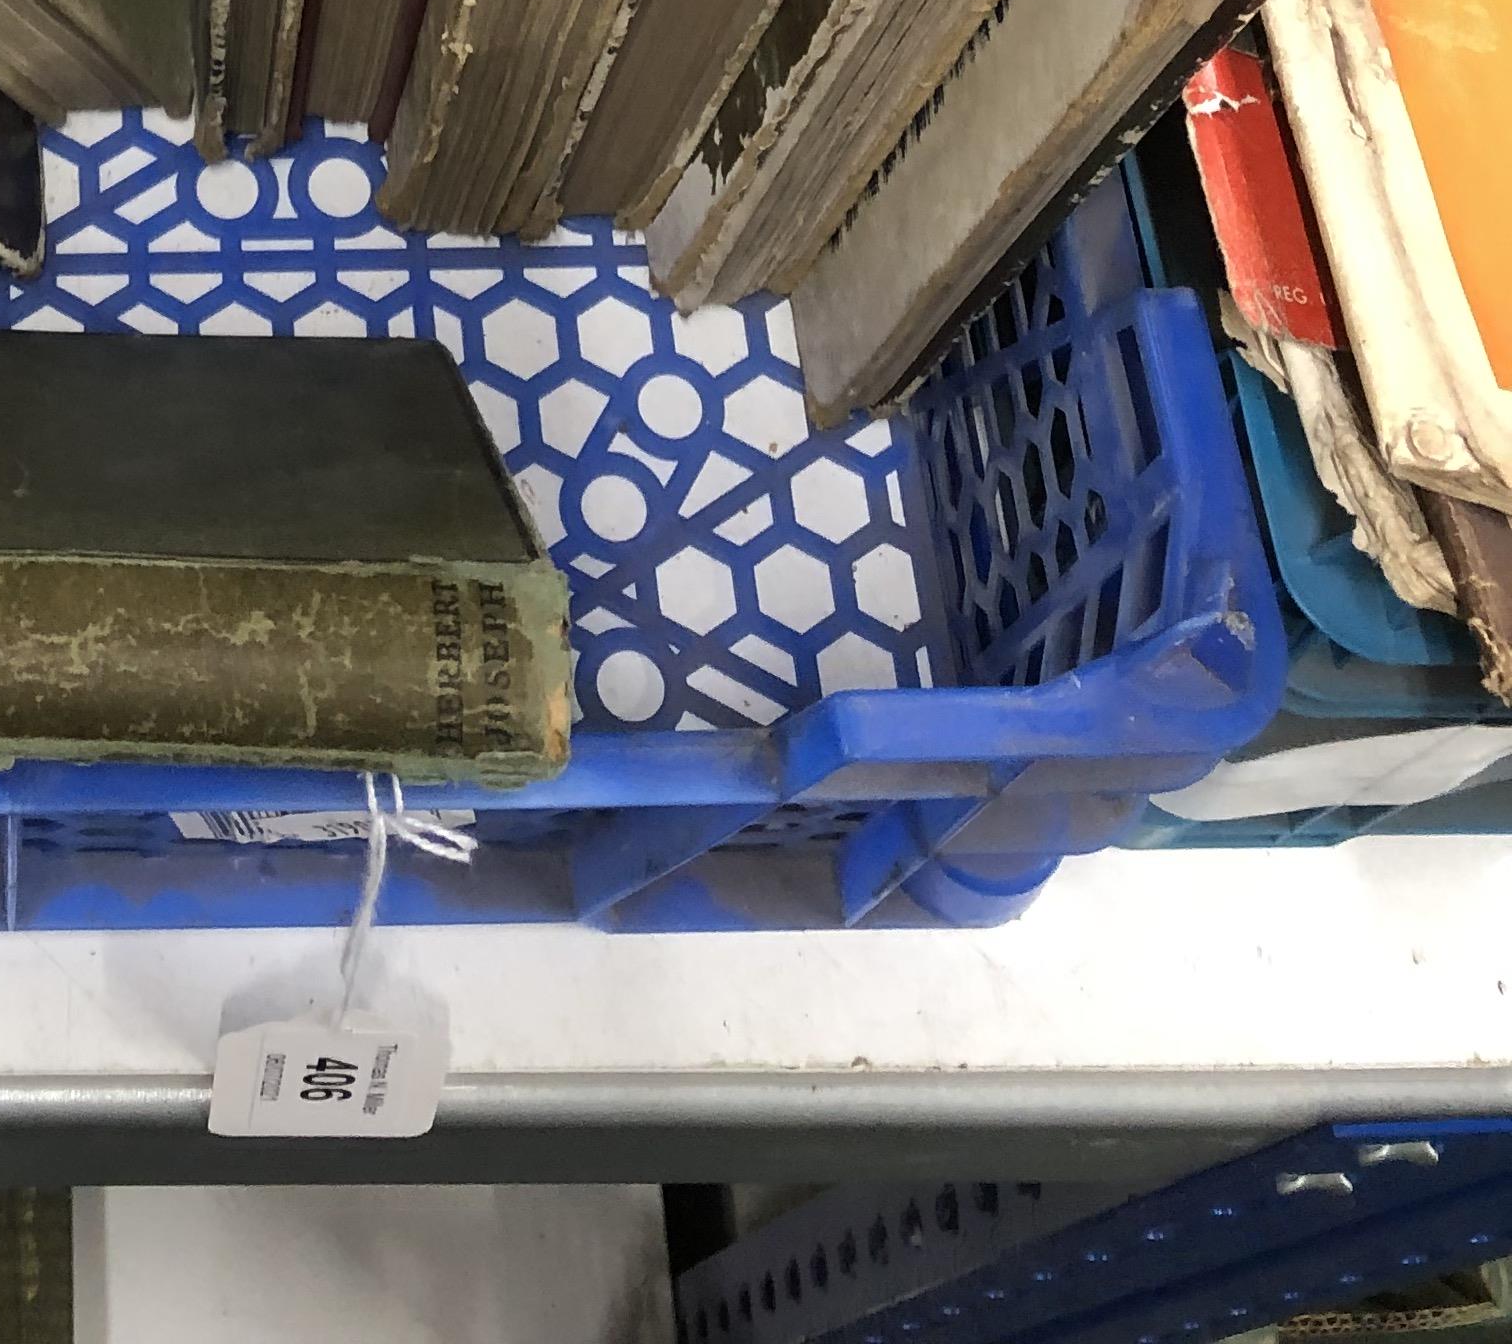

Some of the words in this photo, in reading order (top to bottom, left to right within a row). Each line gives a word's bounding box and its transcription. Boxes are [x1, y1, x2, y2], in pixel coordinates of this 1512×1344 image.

[431, 578, 464, 745] HERBERT
[479, 581, 513, 746] JOSEPH
[300, 1057, 358, 1100] 406
